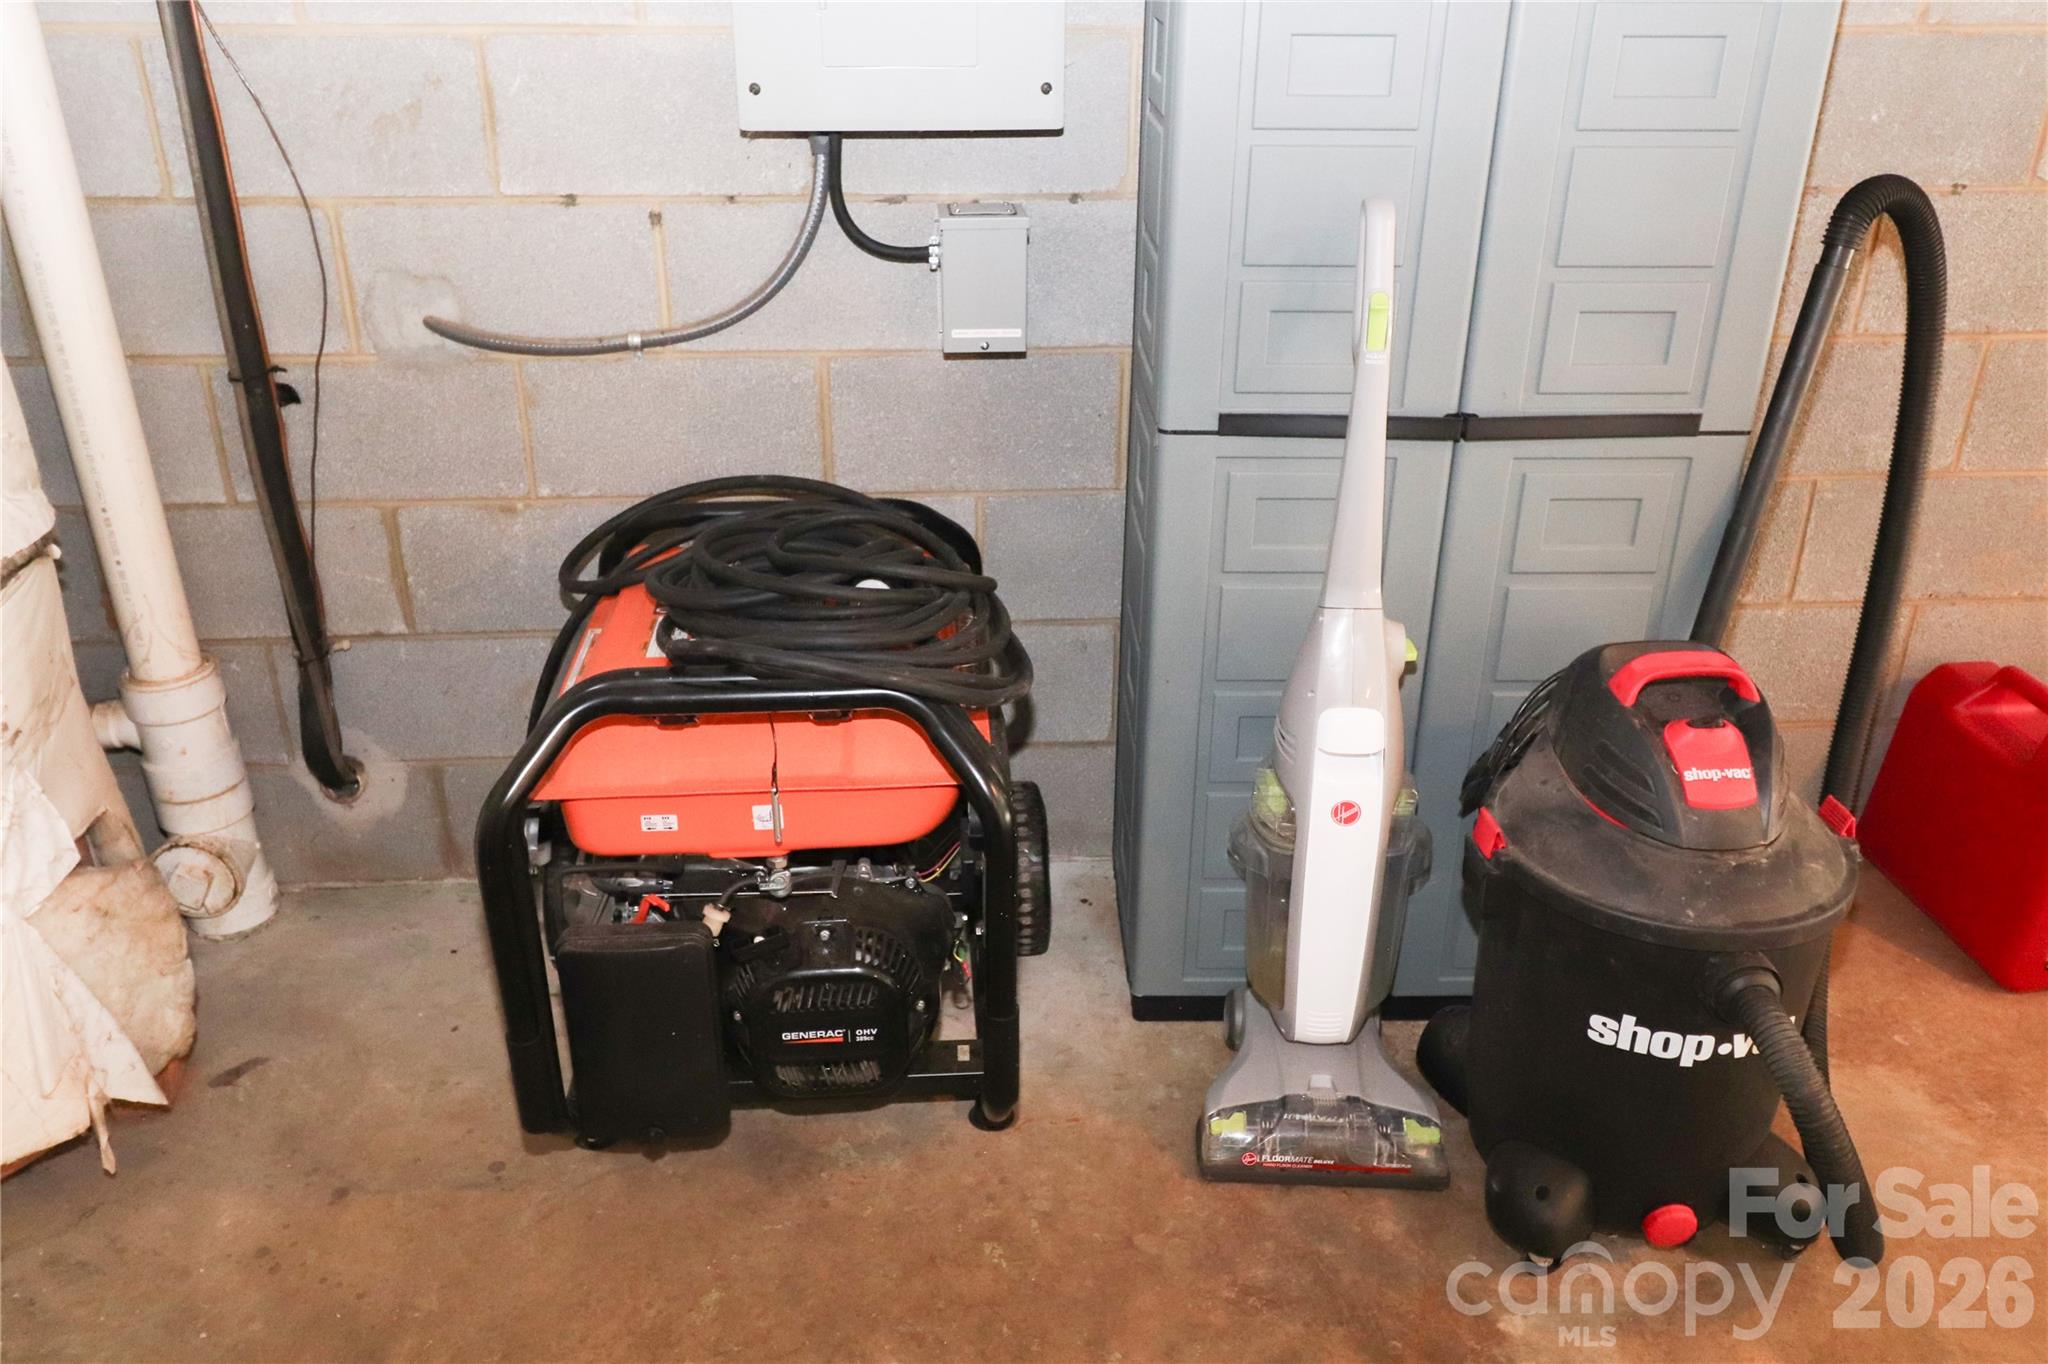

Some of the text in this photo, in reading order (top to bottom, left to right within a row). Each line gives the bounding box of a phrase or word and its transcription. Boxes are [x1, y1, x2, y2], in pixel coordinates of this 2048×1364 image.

[781, 1029, 844, 1040] GENERAC
[855, 1028, 878, 1036] OHV
[1261, 1154, 1314, 1164] FLOORMATE
